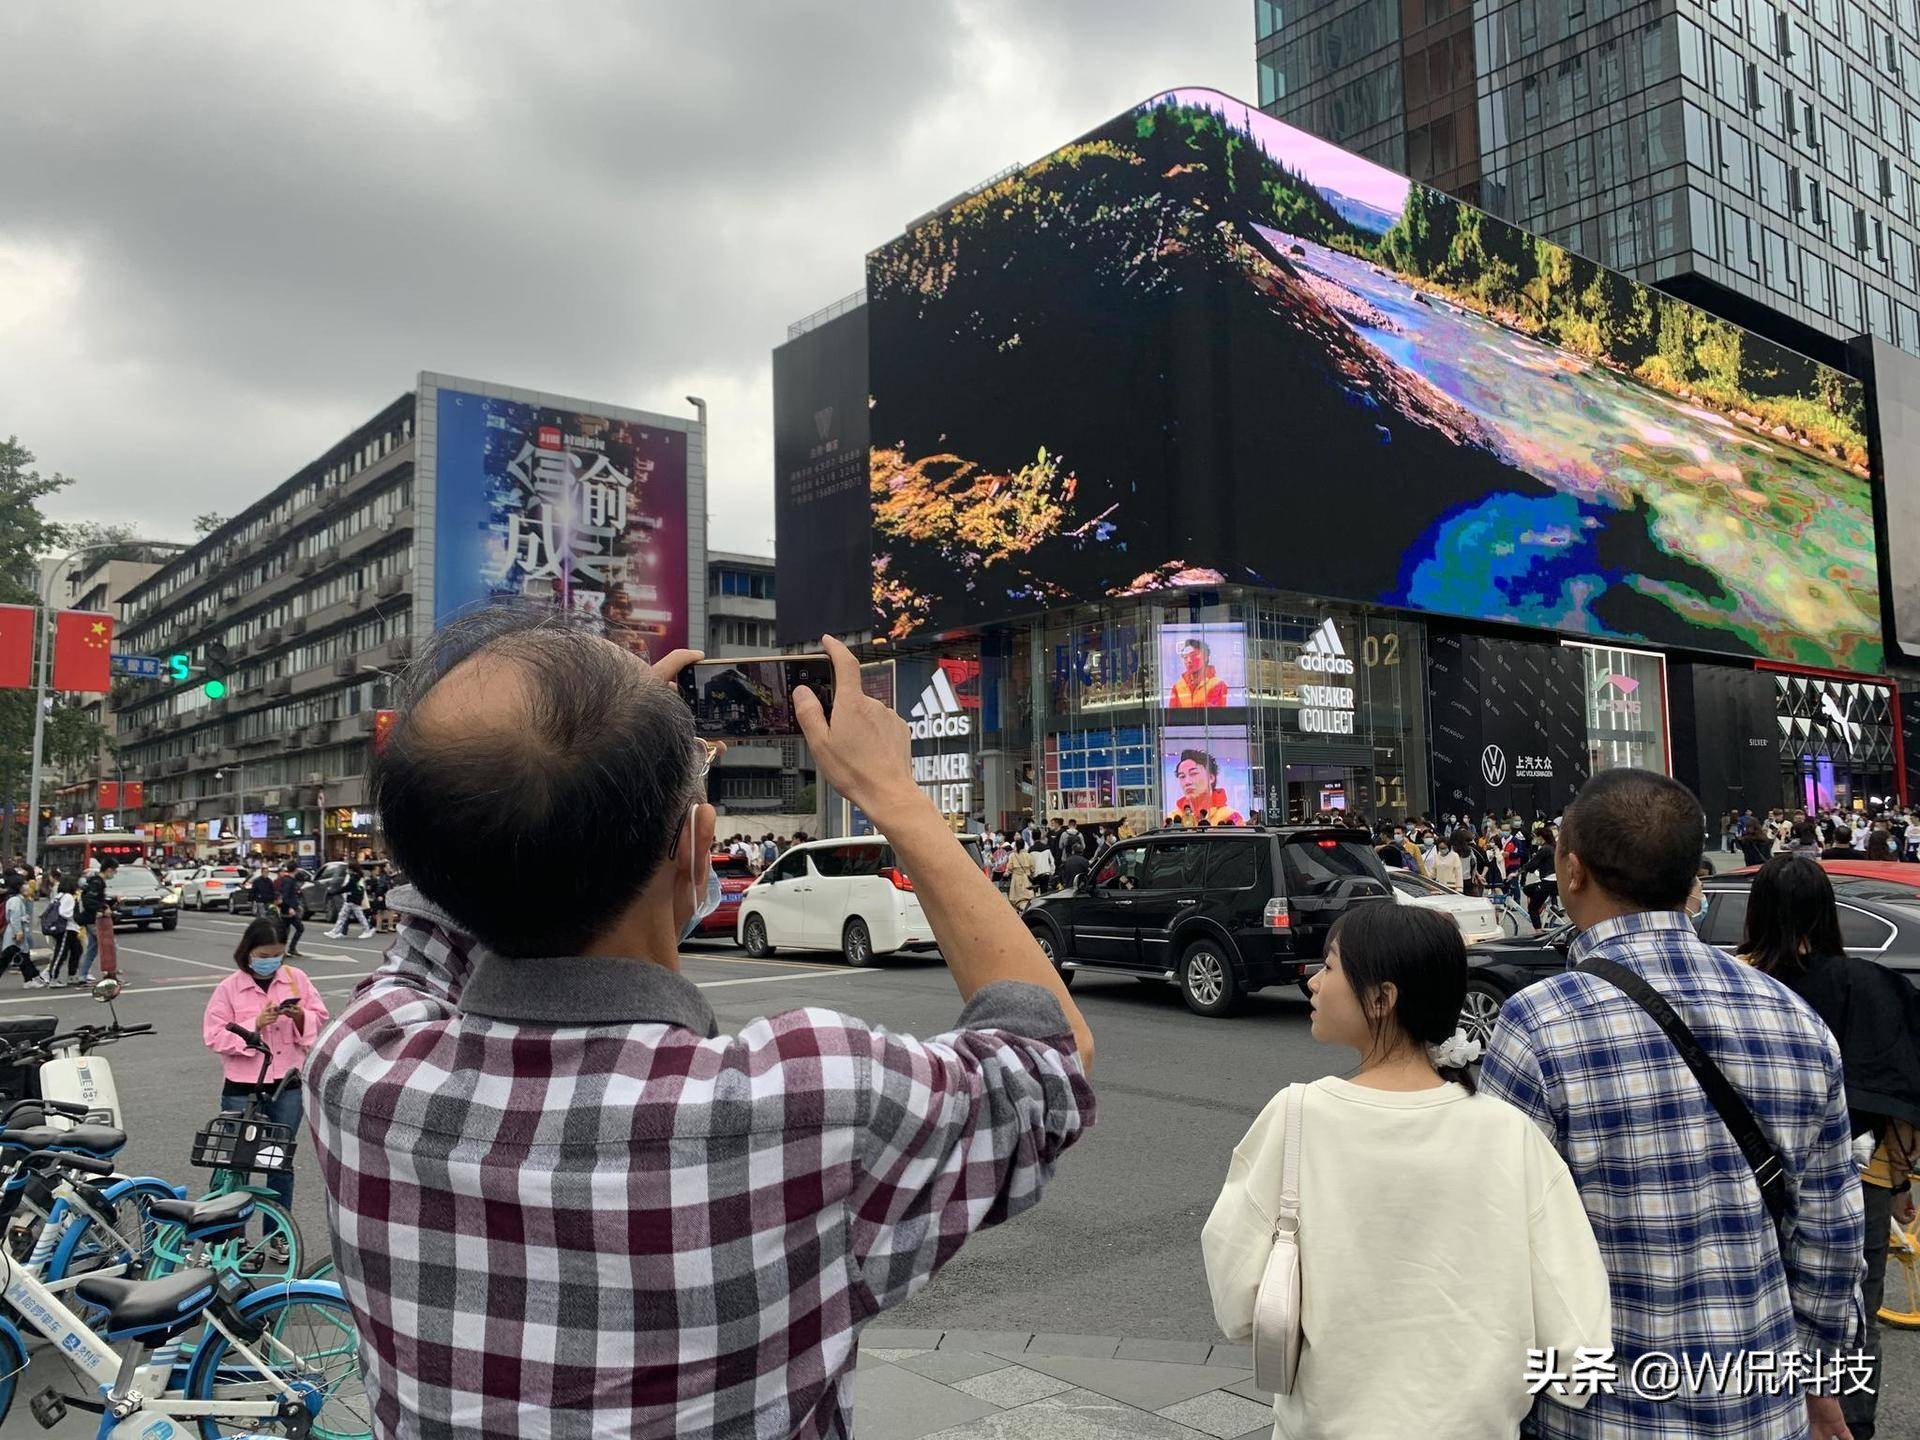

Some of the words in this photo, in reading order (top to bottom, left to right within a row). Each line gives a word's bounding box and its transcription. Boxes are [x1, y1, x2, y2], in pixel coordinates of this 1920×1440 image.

[1363, 633, 1401, 667] 02
[1300, 654, 1354, 675] adidas
[1301, 685, 1354, 709] SNEAKER
[1303, 709, 1355, 734] COLLECT
[1515, 755, 1553, 770] 上汽大众
